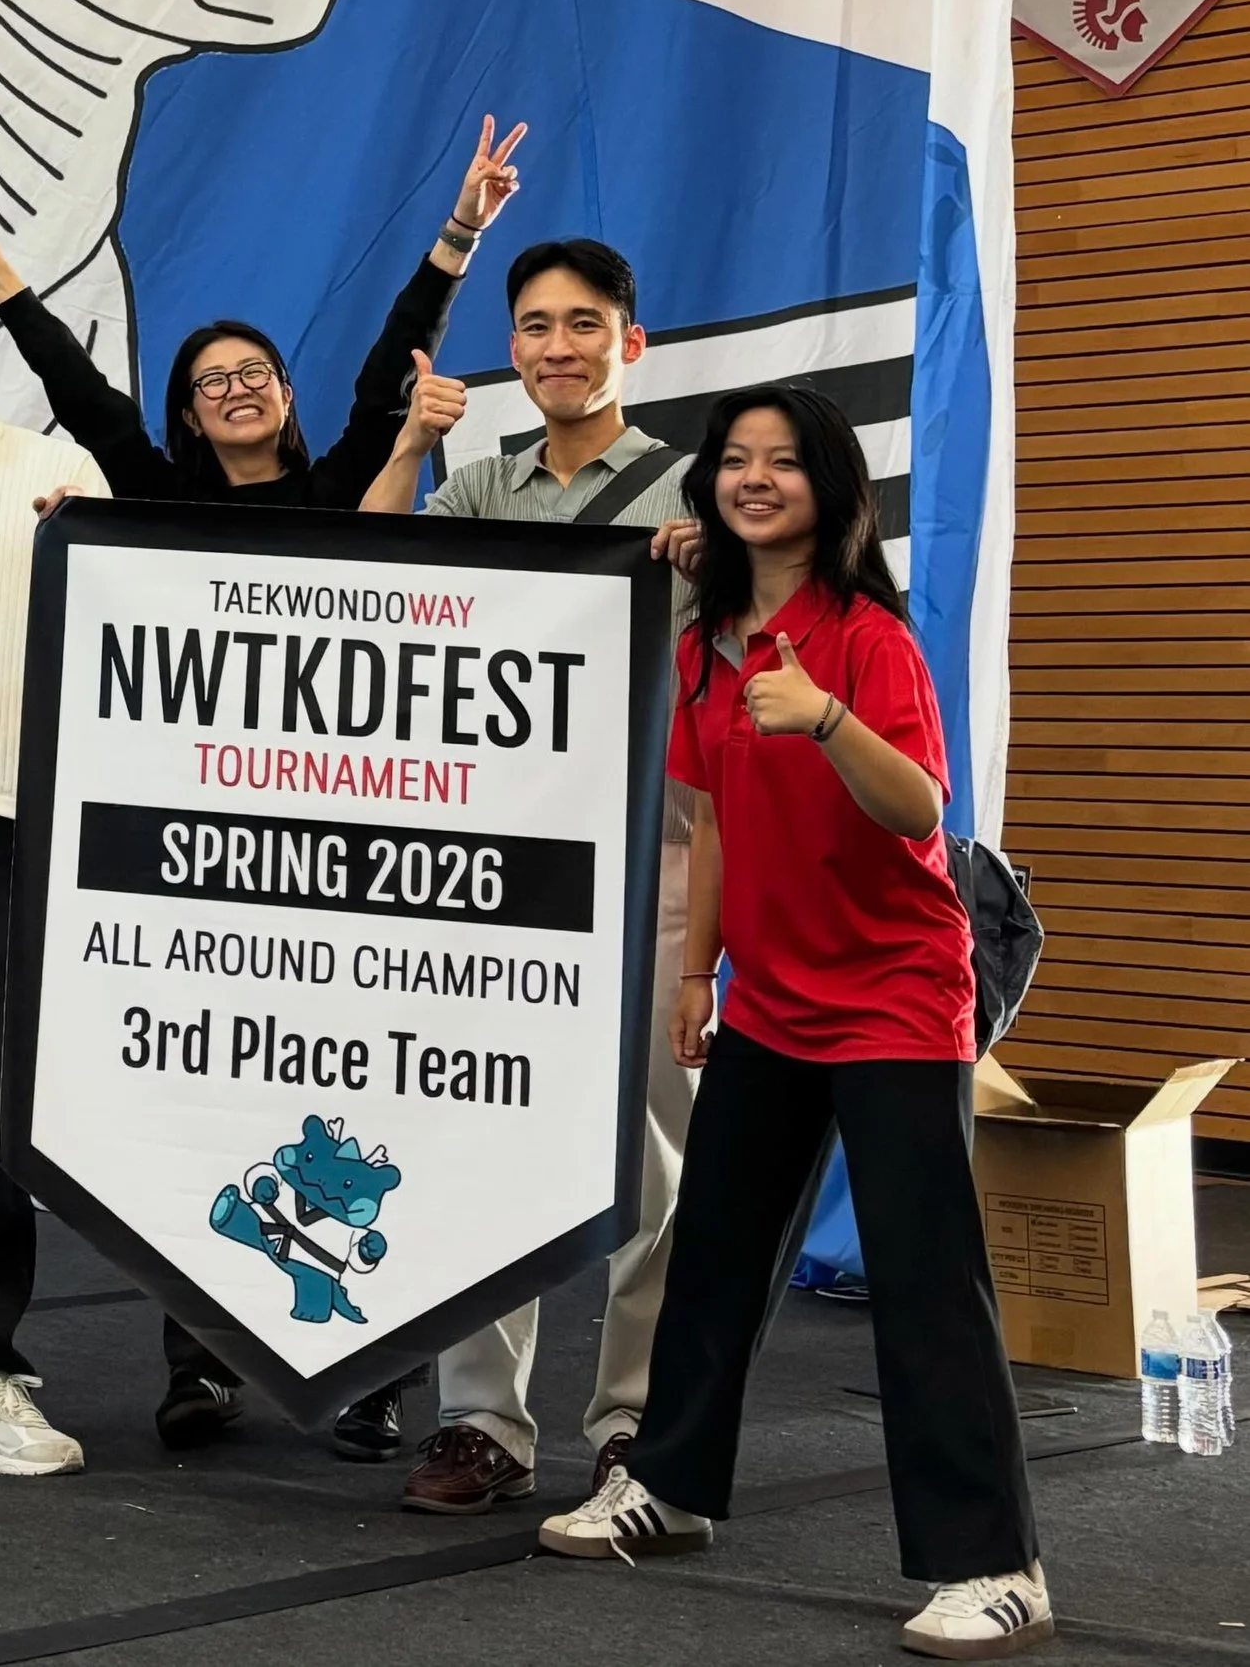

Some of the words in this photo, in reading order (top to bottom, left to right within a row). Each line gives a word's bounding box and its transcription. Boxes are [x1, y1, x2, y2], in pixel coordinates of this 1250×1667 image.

[209, 580, 475, 628] TAEKWONDOWAY
[98, 622, 586, 752] NWTKDFEST
[194, 743, 476, 805] TOURNAMENT
[160, 821, 348, 899] SPRING
[366, 838, 504, 911] 2026
[83, 921, 151, 968] ALL
[164, 928, 336, 985] AROUND
[352, 945, 581, 1007] CHAMPION
[121, 1005, 211, 1076] 3rd
[230, 1015, 369, 1091] Place
[388, 1030, 531, 1108] Team
